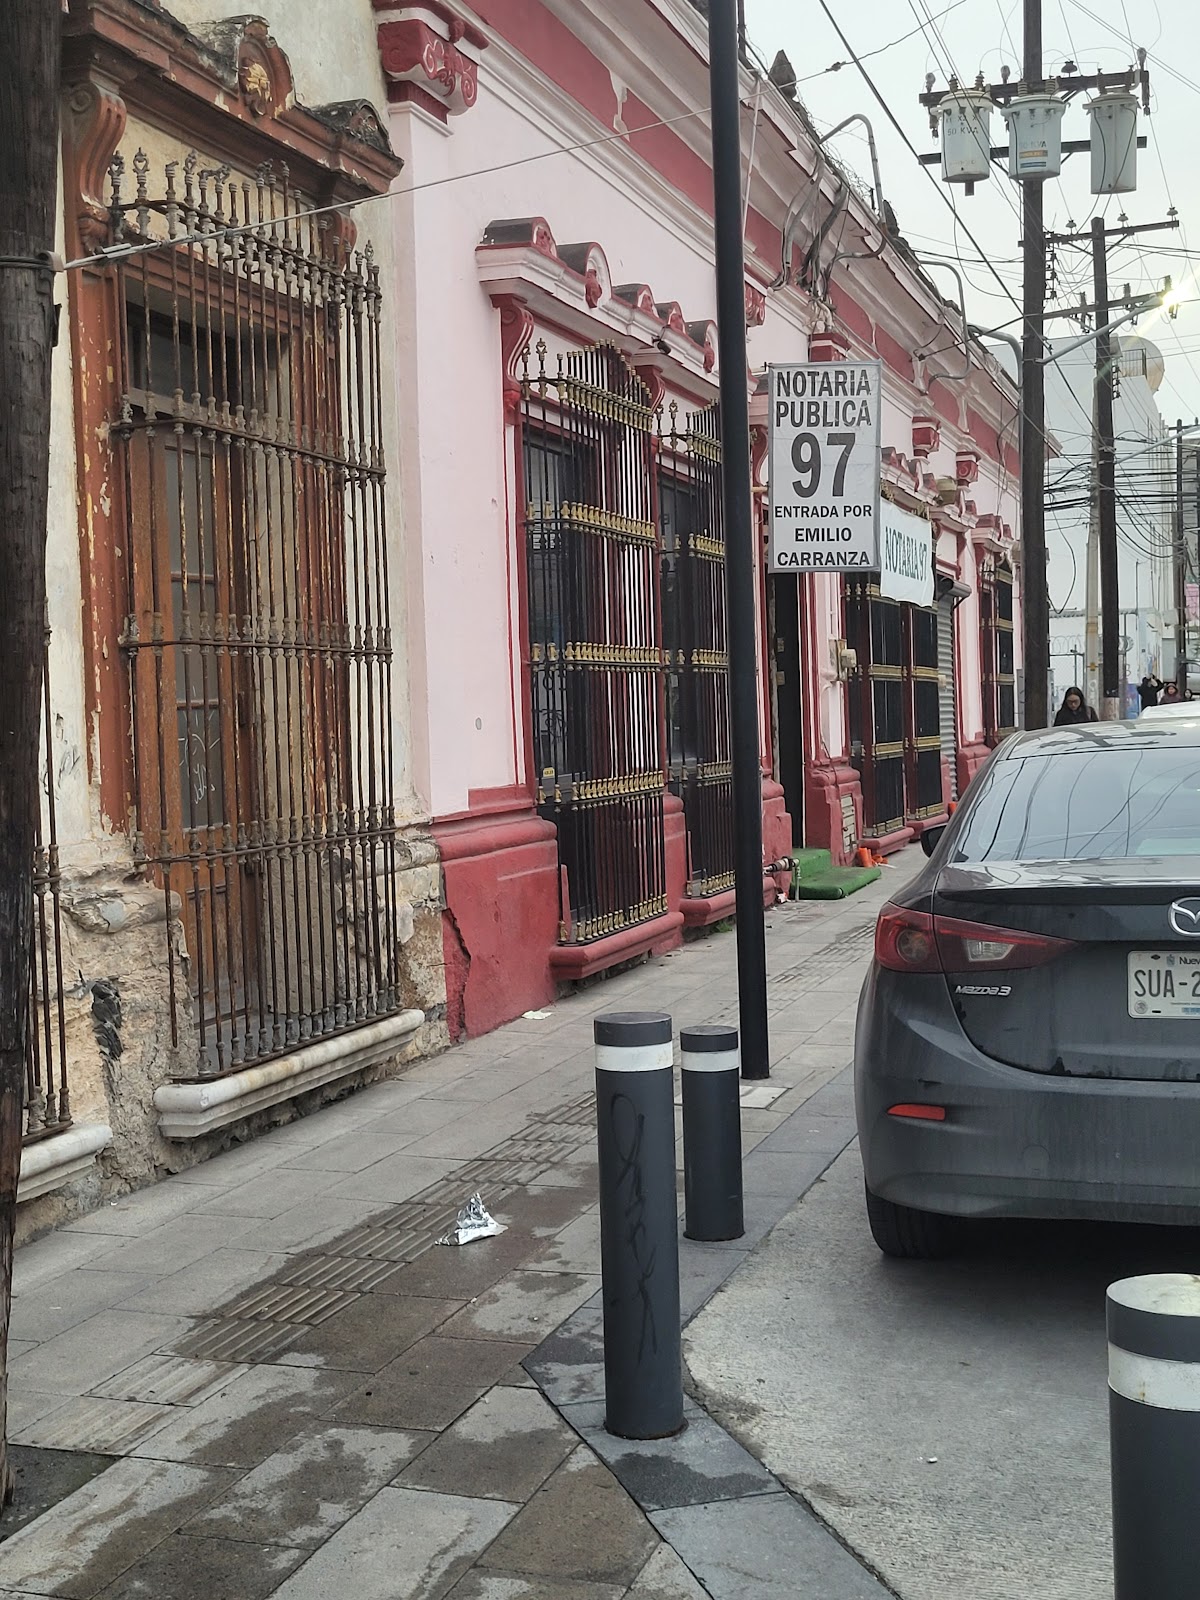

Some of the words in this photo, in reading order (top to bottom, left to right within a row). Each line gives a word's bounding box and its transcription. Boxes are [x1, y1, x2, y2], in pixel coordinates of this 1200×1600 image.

[947, 127, 957, 136] 50
[960, 126, 979, 135] KVA
[777, 369, 871, 397] NOTARIA
[776, 400, 872, 427] PUBLICA
[790, 432, 856, 498] 97
[774, 506, 839, 518] ENTRADA
[843, 505, 872, 517] POR
[795, 527, 852, 542] EMILIO
[777, 551, 870, 566] CARRANZA
[885, 525, 919, 581] NOTARIA
[919, 541, 928, 582] 97
[1134, 969, 1200, 998] SUA-2
